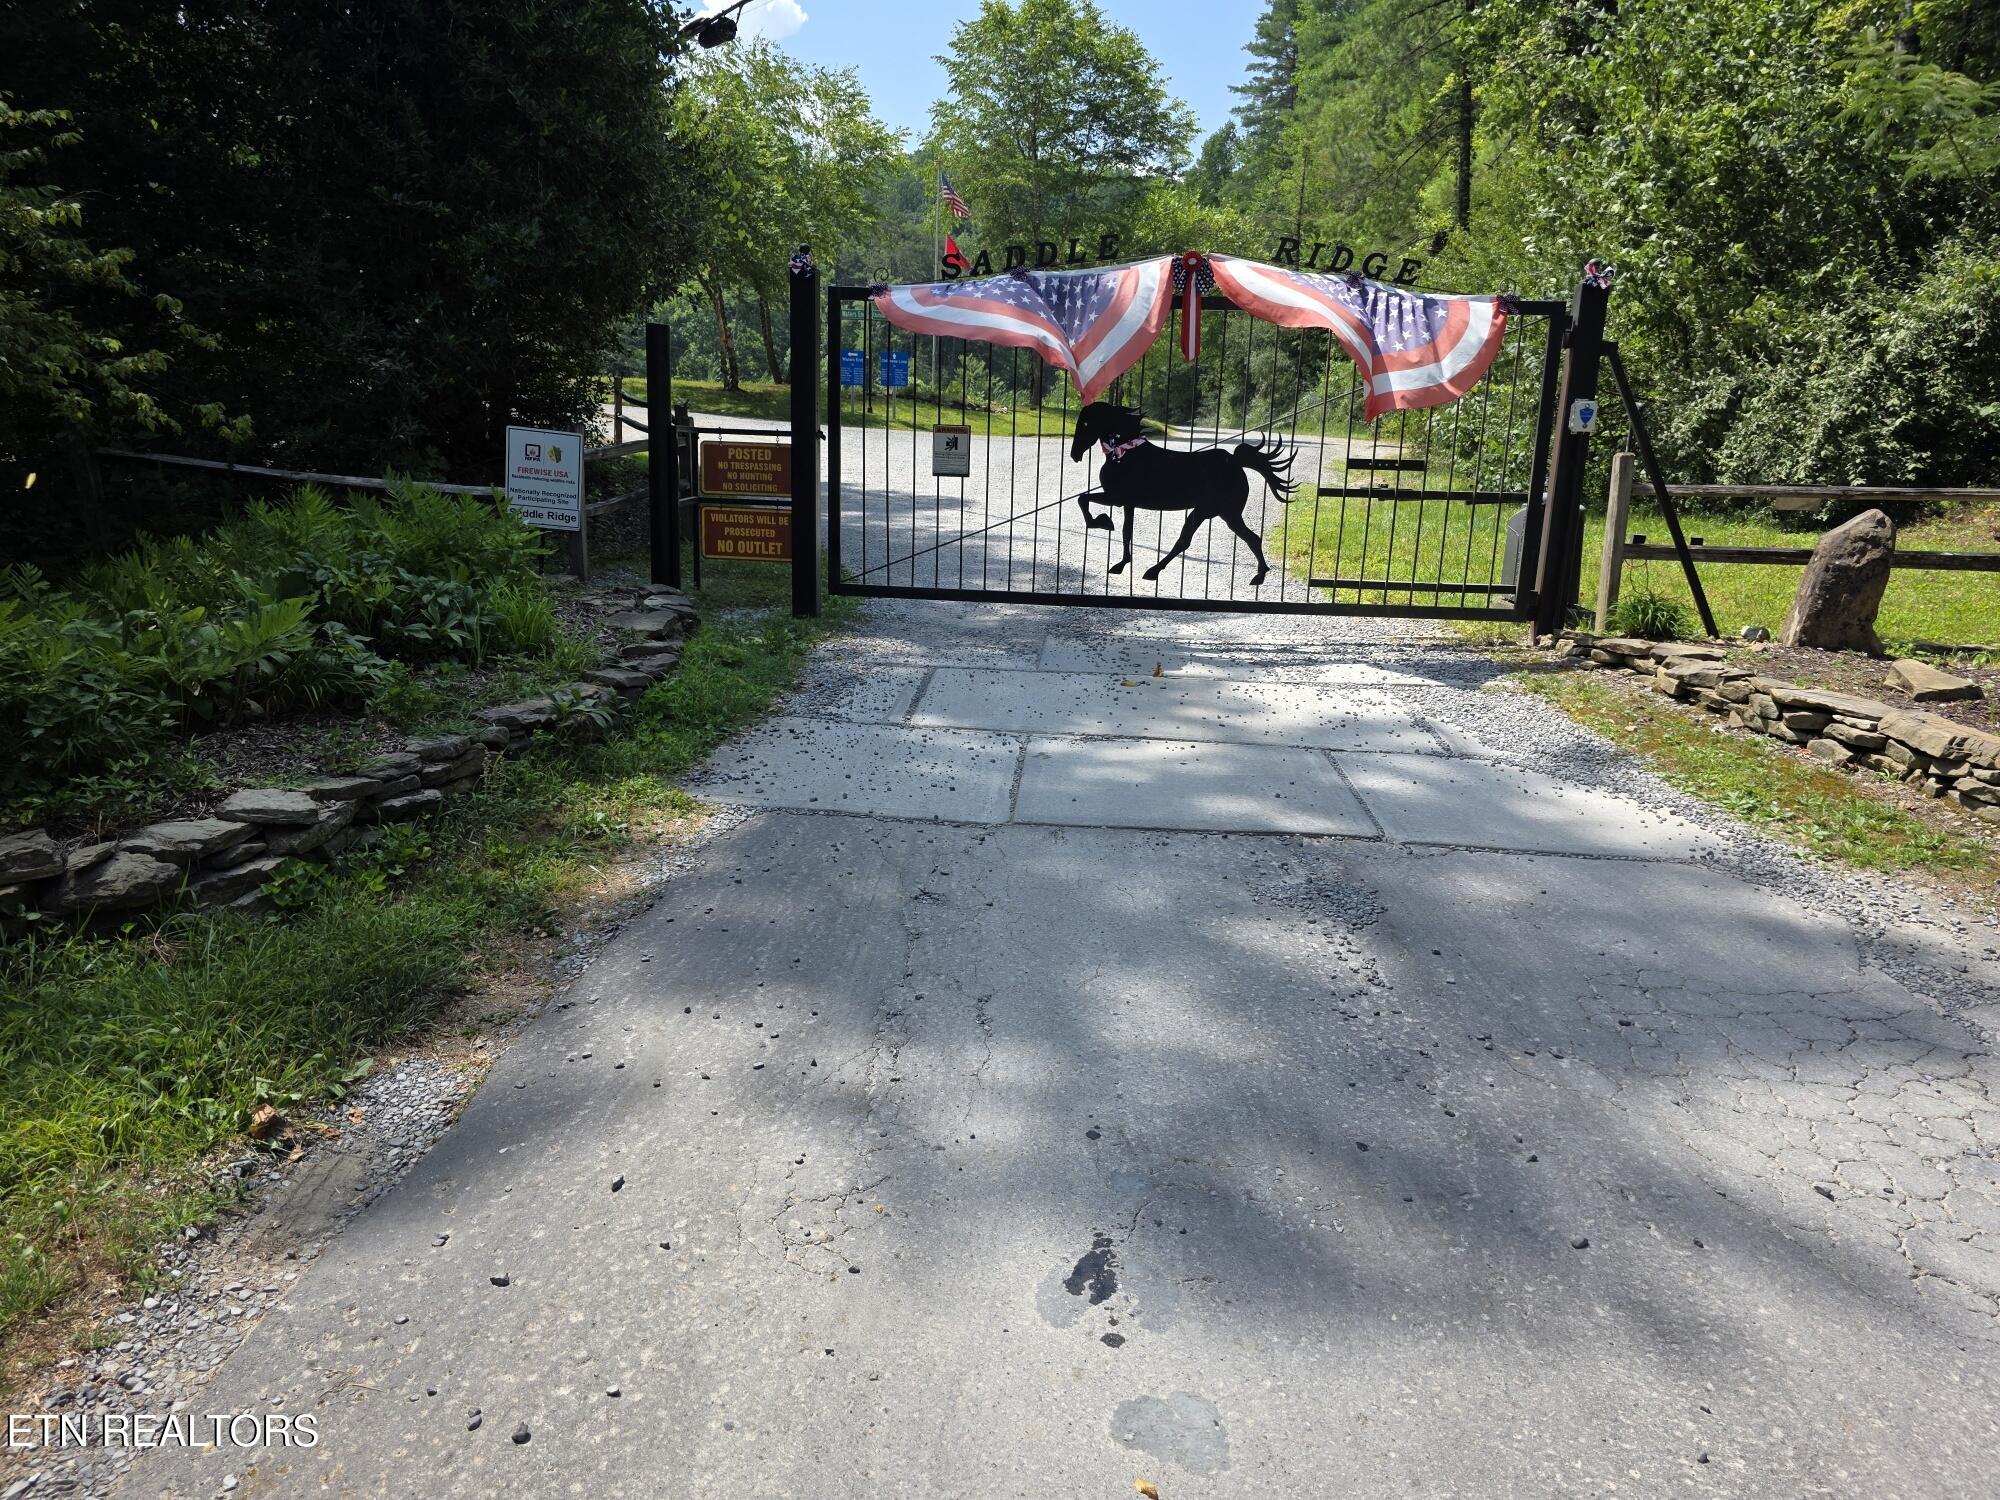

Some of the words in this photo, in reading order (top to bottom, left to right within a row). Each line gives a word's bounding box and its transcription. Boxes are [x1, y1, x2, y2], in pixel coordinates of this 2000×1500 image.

[941, 233, 1120, 281] SADDLE
[1271, 235, 1423, 285] RIDGE
[728, 448, 772, 461] POSTED
[517, 466, 553, 477] FIREWISE
[718, 461, 729, 470] NO
[731, 462, 782, 472] TRESPASSING
[727, 471, 738, 480] NO
[739, 472, 773, 481] HUNTING
[722, 482, 733, 490] NO
[735, 483, 778, 492] SOLICITING
[509, 487, 541, 496] Nationally
[541, 490, 577, 500] Recognized
[517, 494, 556, 505] Participating
[509, 507, 544, 520] Sddle
[547, 511, 577, 523] Ridge
[710, 513, 754, 524] VIOLATORS
[756, 515, 777, 525] WILL
[778, 516, 789, 526] BE
[724, 527, 776, 538] PROSECUTED
[717, 540, 734, 553] NO
[737, 541, 783, 555] OUTLET
